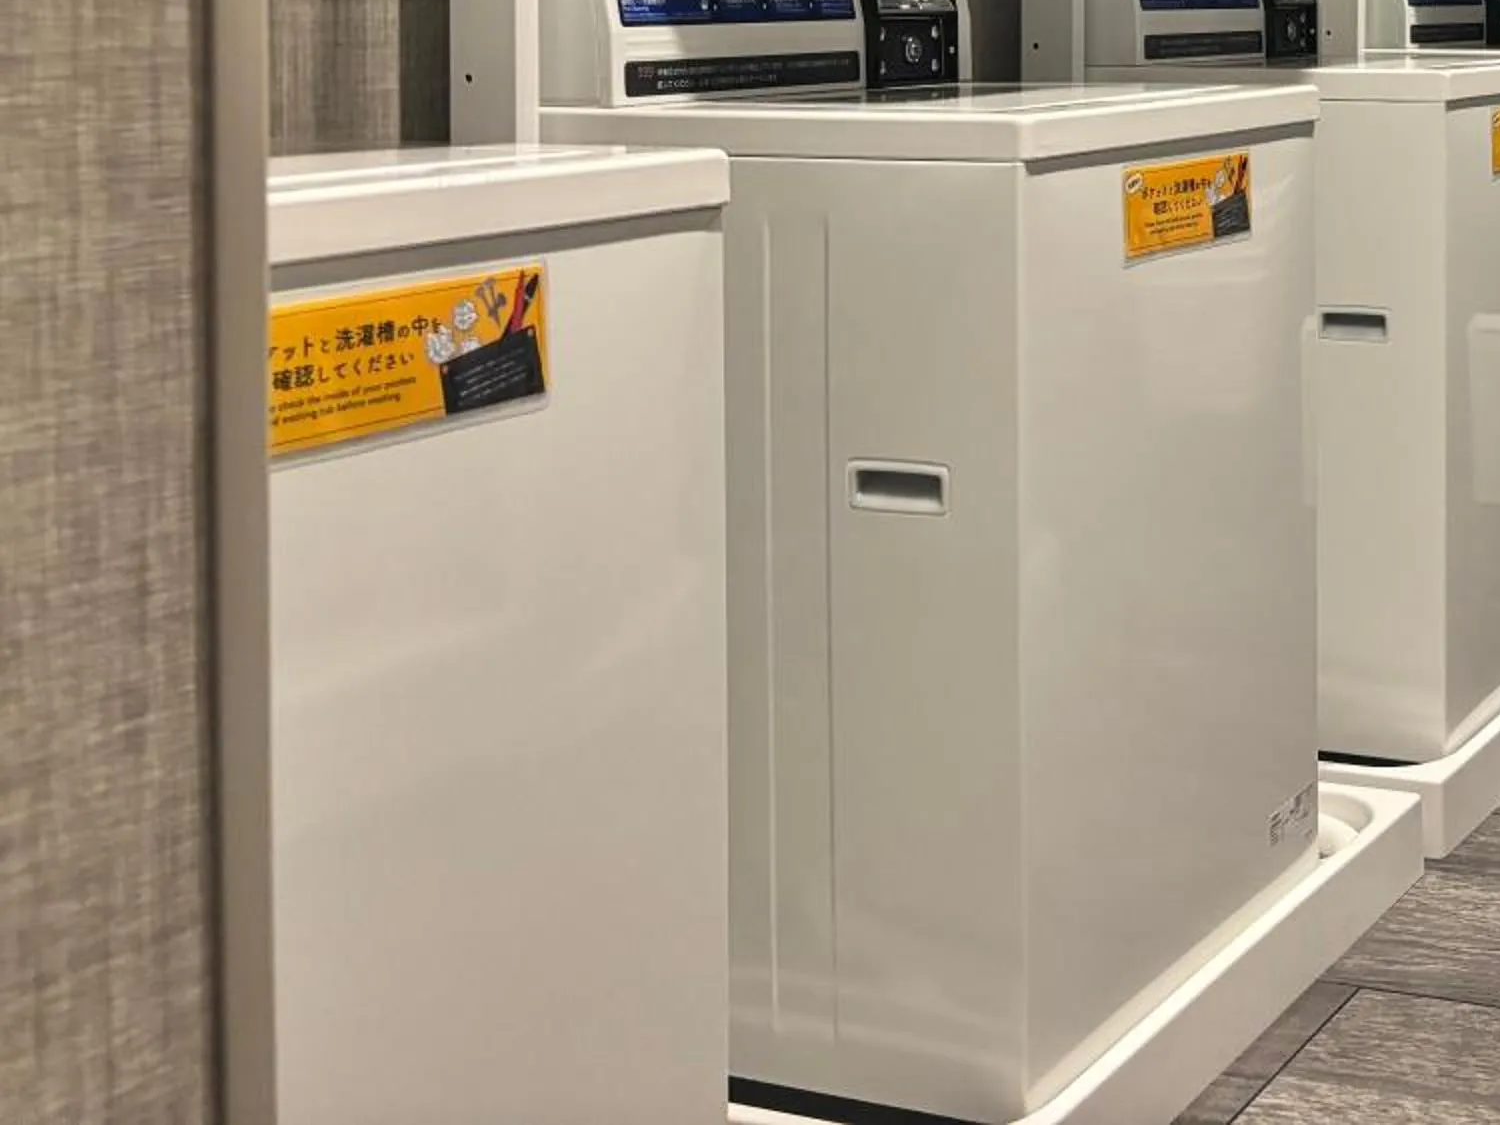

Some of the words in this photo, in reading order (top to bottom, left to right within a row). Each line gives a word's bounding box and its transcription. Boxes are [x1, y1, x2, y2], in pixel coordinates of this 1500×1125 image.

[272, 352, 415, 391] 確認してください
